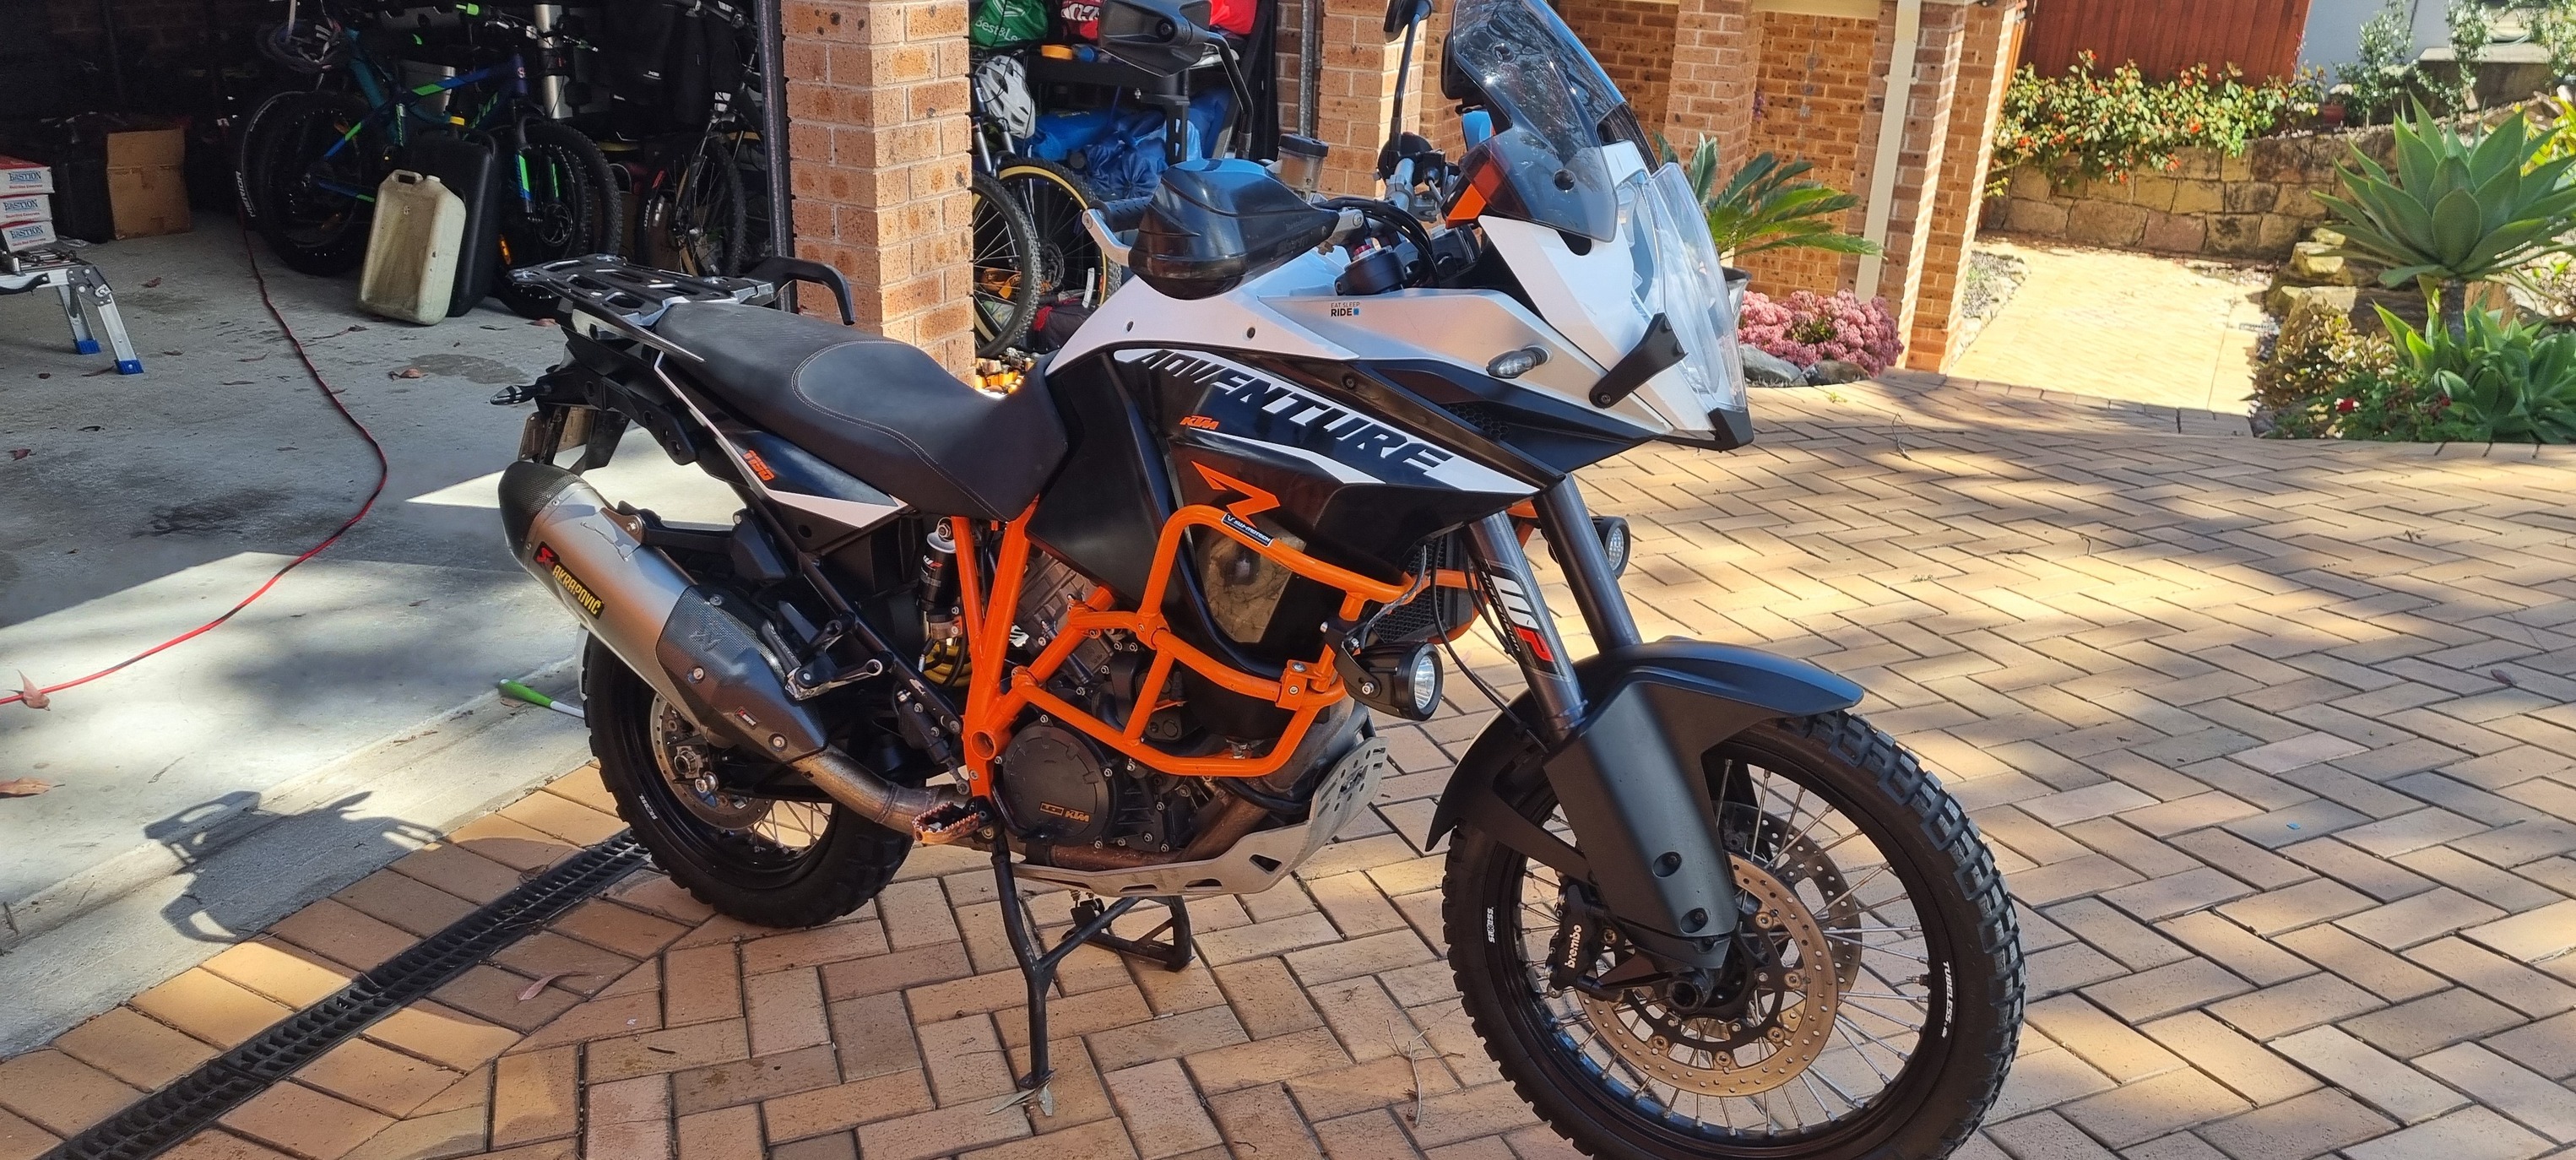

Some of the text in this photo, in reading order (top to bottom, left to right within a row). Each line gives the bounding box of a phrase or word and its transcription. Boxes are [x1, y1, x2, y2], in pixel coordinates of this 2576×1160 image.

[8, 171, 41, 182] BASTION
[3, 199, 38, 210] BASTION
[9, 225, 44, 239] BASTION
[1331, 308, 1353, 317] RIDE
[1133, 349, 1454, 474] ADVENTURE
[1180, 415, 1220, 431] KTM
[1481, 571, 1521, 652] SUSPENSION
[1489, 575, 1554, 662] WP
[1065, 809, 1090, 822] KTM
[1565, 924, 1582, 969] brembo
[1943, 961, 1953, 1024] TUBELESS
